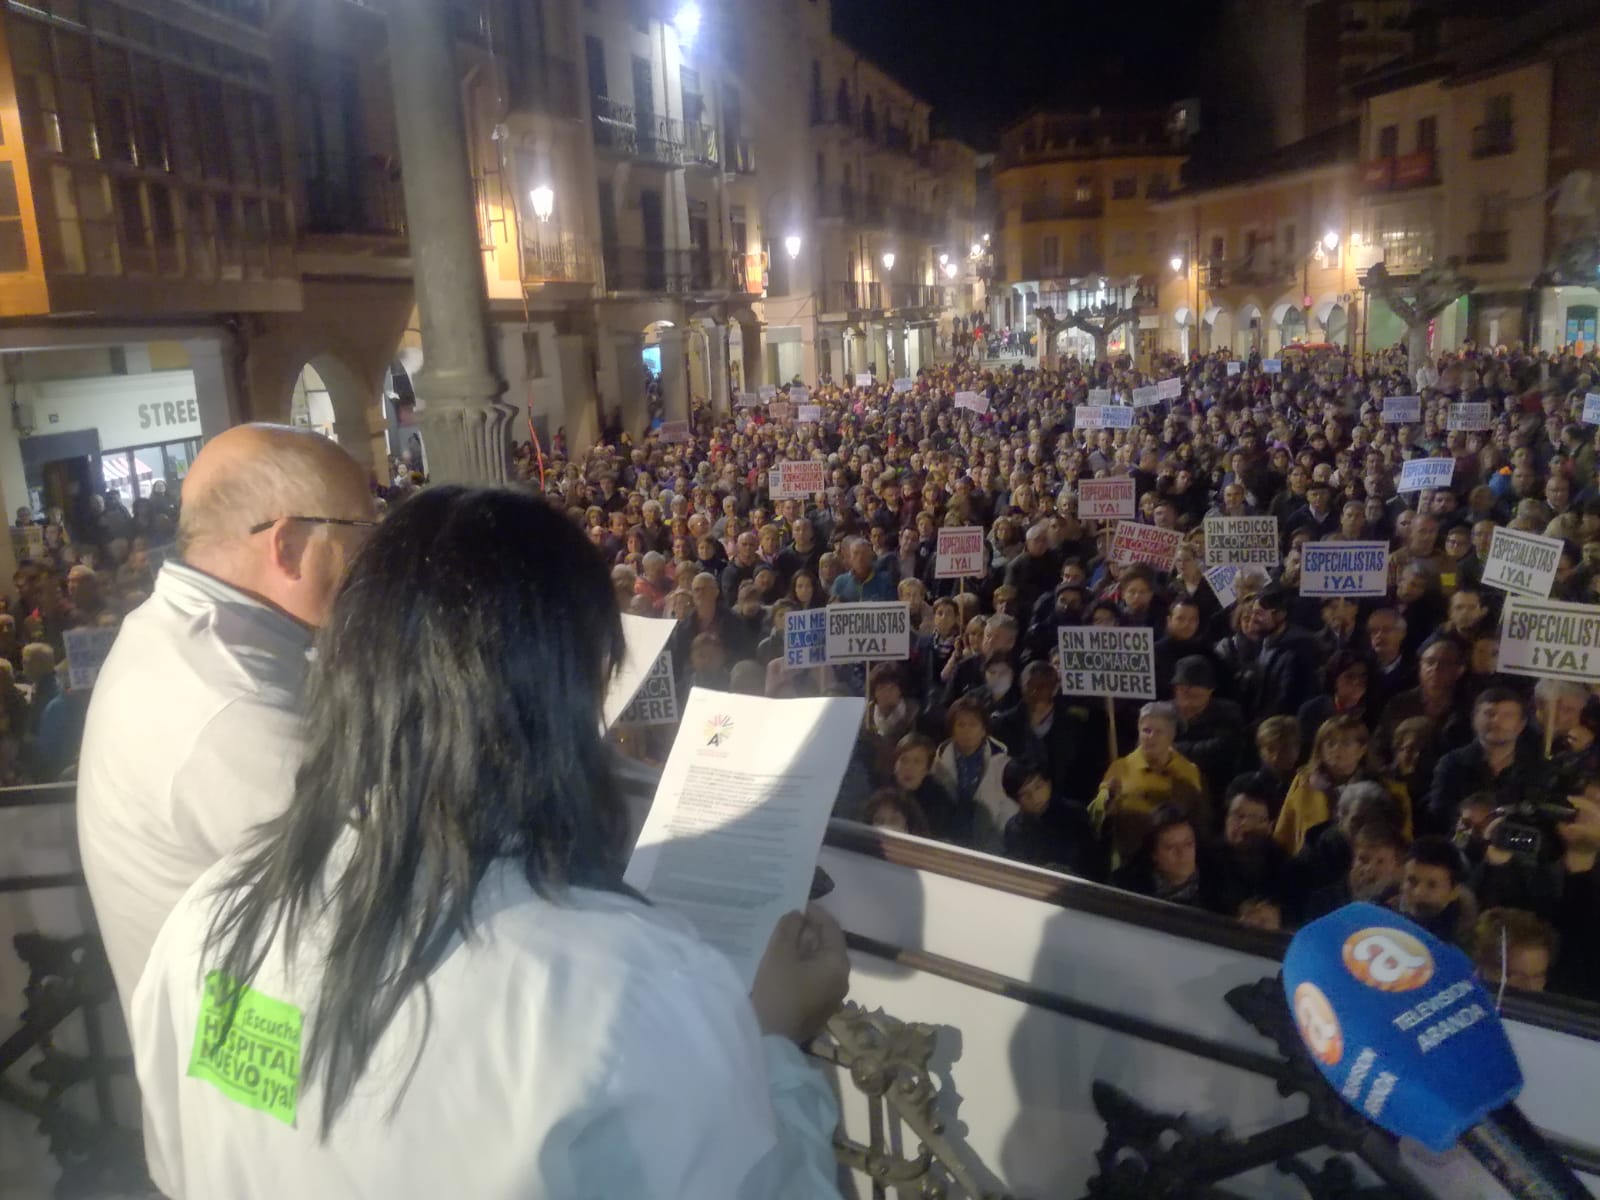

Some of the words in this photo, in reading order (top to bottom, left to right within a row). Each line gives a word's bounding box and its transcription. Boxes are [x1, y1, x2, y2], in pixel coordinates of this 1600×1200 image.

[138, 399, 198, 430] STREE
[1094, 503, 1119, 513] ¡YA!
[1118, 524, 1136, 538] SIN
[1137, 527, 1179, 545] MEDICOS
[1207, 521, 1224, 534] SIN
[1228, 520, 1274, 534] MEDICOS
[939, 535, 980, 555] ESPECIALISTAS
[1492, 537, 1557, 573] ESPECIALISTAS
[950, 557, 971, 569] ¡YA!
[1209, 550, 1223, 563] SE
[1229, 550, 1276, 563] MUERE
[1305, 551, 1384, 572] ESPECIALISTAS
[1324, 575, 1363, 590] ¡YA!
[1500, 565, 1532, 587] ¡YA!
[788, 614, 806, 631] SIN
[830, 612, 906, 636] ESPECIALISTAS
[1508, 609, 1600, 648] ESPECIALIST
[848, 638, 887, 653] ¡YA!
[1063, 631, 1085, 649] SIN
[1089, 631, 1149, 651] MEDICOS
[788, 650, 803, 665] SE
[1065, 653, 1080, 669] LA
[1084, 653, 1149, 672] COMARCA
[1532, 647, 1589, 671] ¡YA!
[1065, 672, 1085, 690] SE
[1092, 672, 1153, 694] MUERE
[620, 698, 674, 722] UERE
[204, 1015, 298, 1080] HSPITAL
